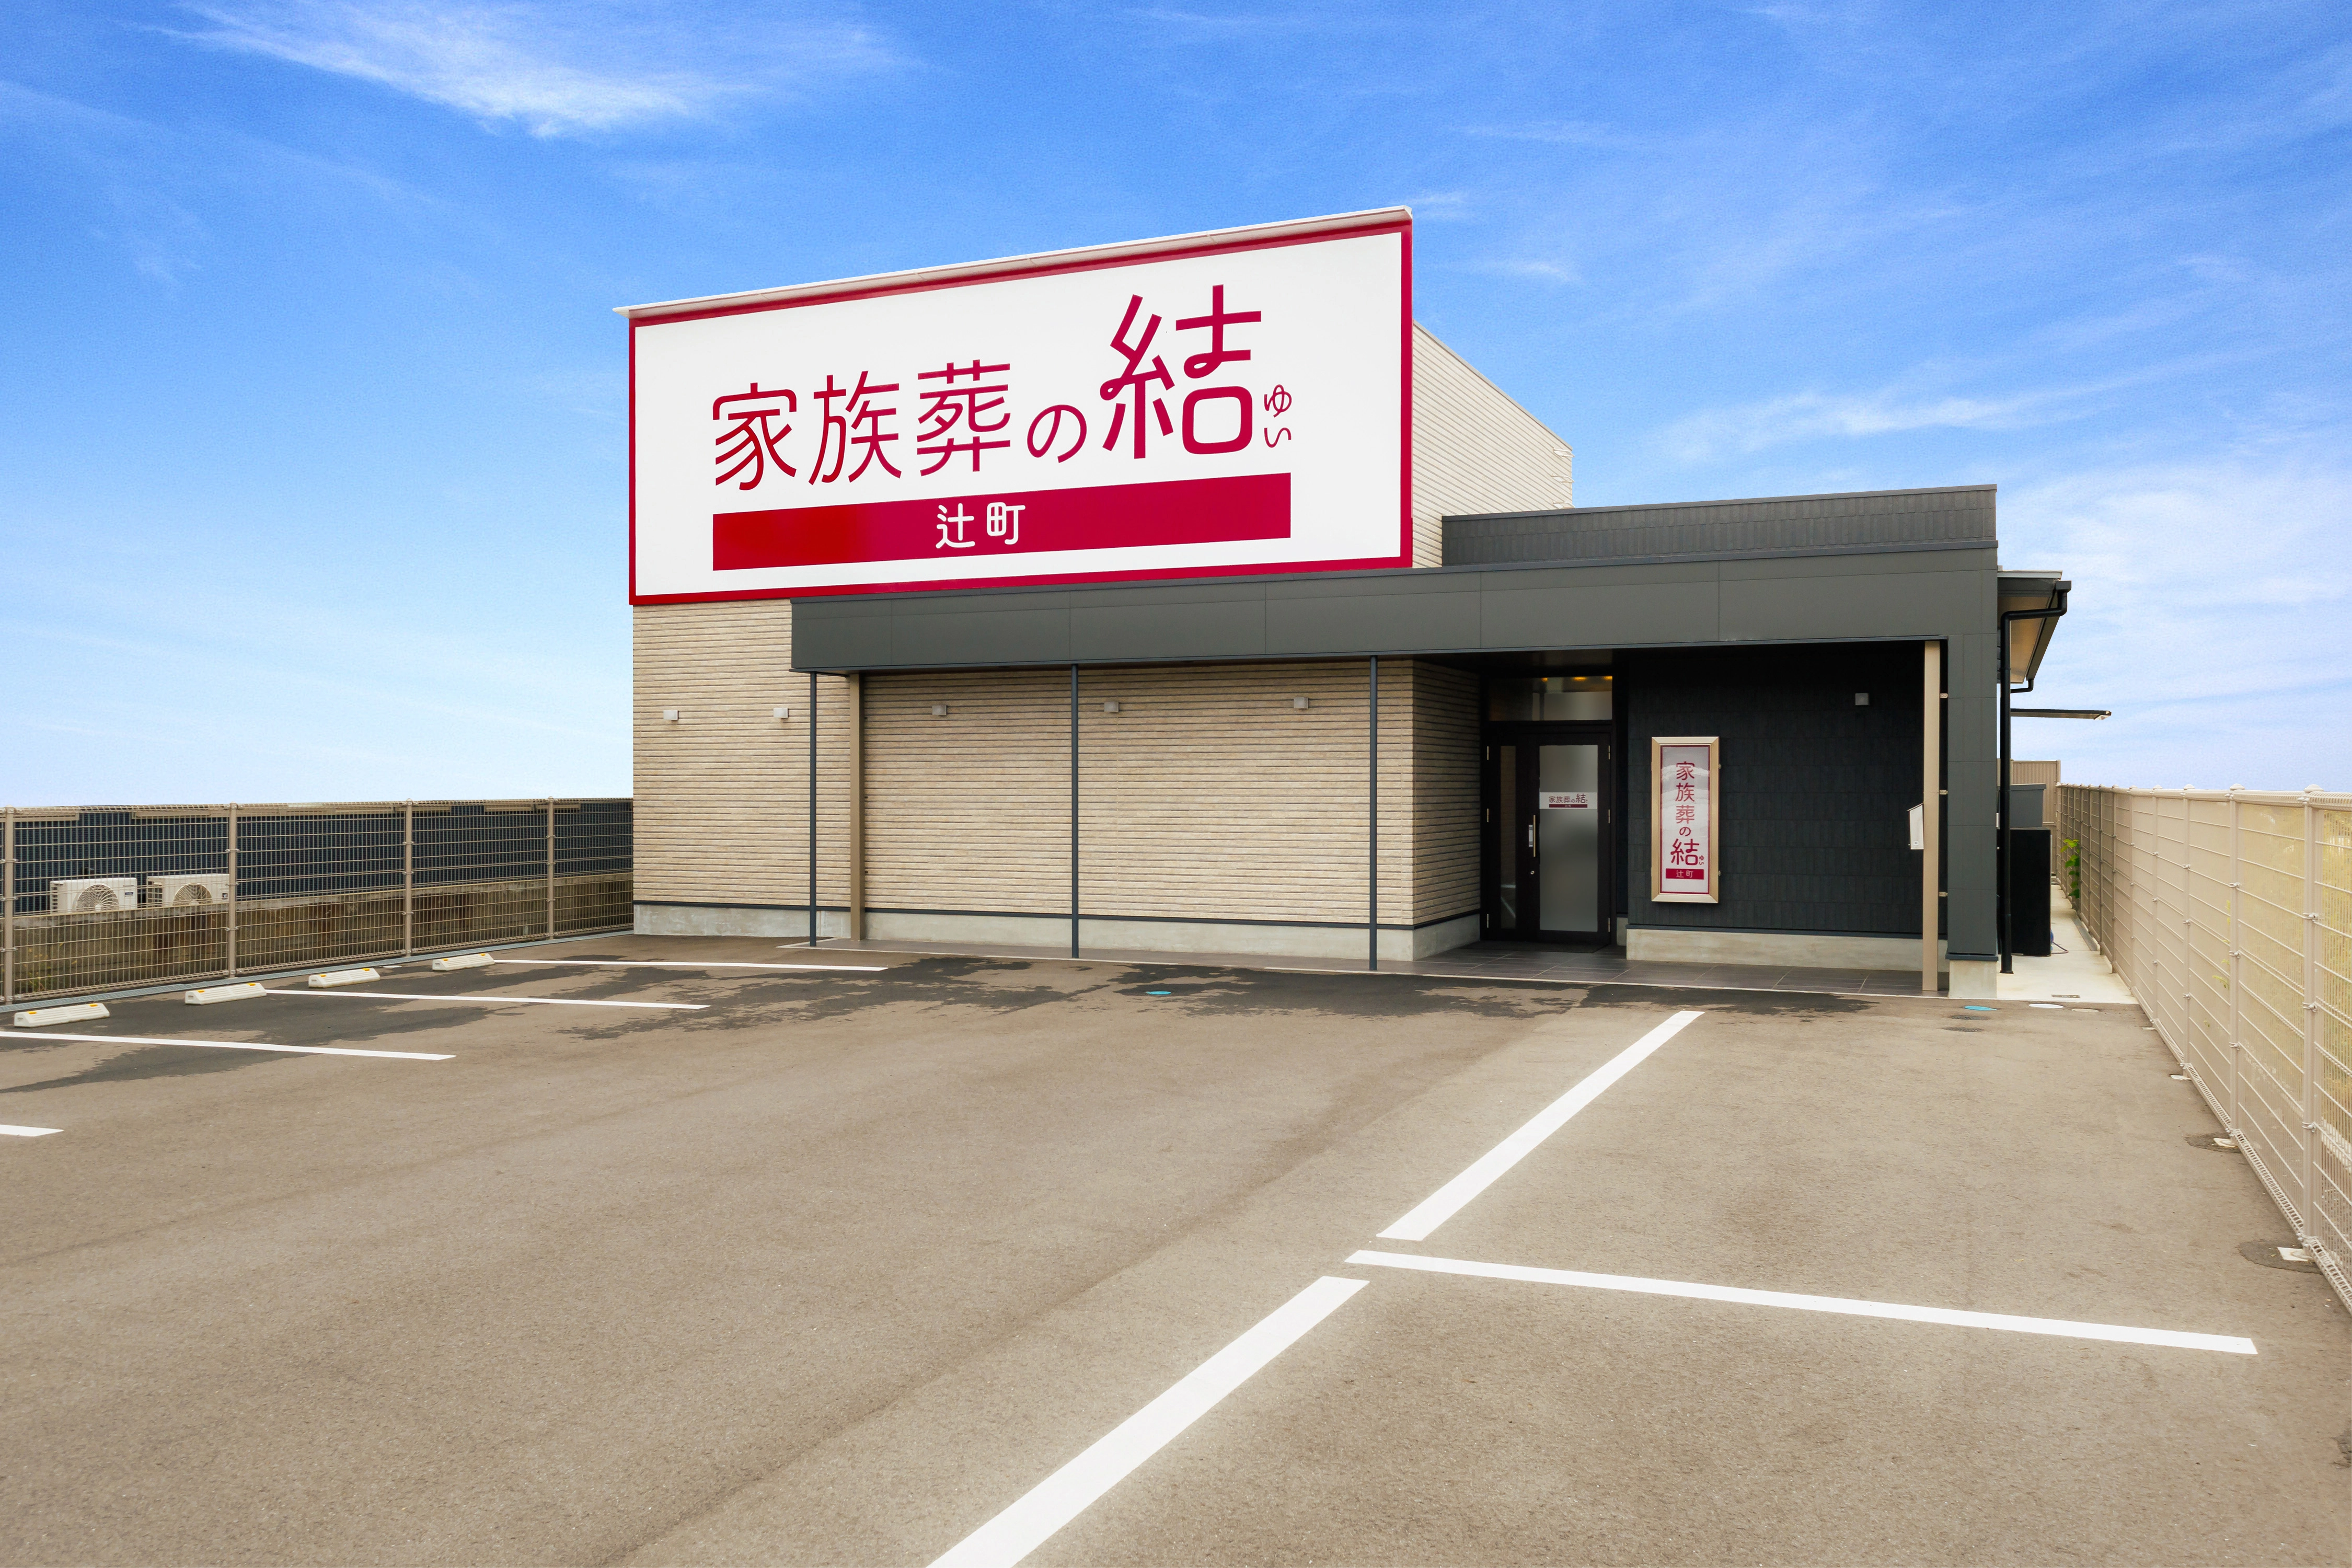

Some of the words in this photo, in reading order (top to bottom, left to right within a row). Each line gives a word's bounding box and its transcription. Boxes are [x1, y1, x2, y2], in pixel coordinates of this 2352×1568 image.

[712, 285, 1261, 491] 家族葬の結
[1264, 385, 1292, 448] ゆい
[935, 502, 1026, 549] 辻町
[1549, 793, 1586, 803] 家族葬の結
[1670, 761, 1700, 866] 家族葬の結
[1676, 870, 1694, 878] 辻町
[1699, 855, 1704, 866] ゆい
